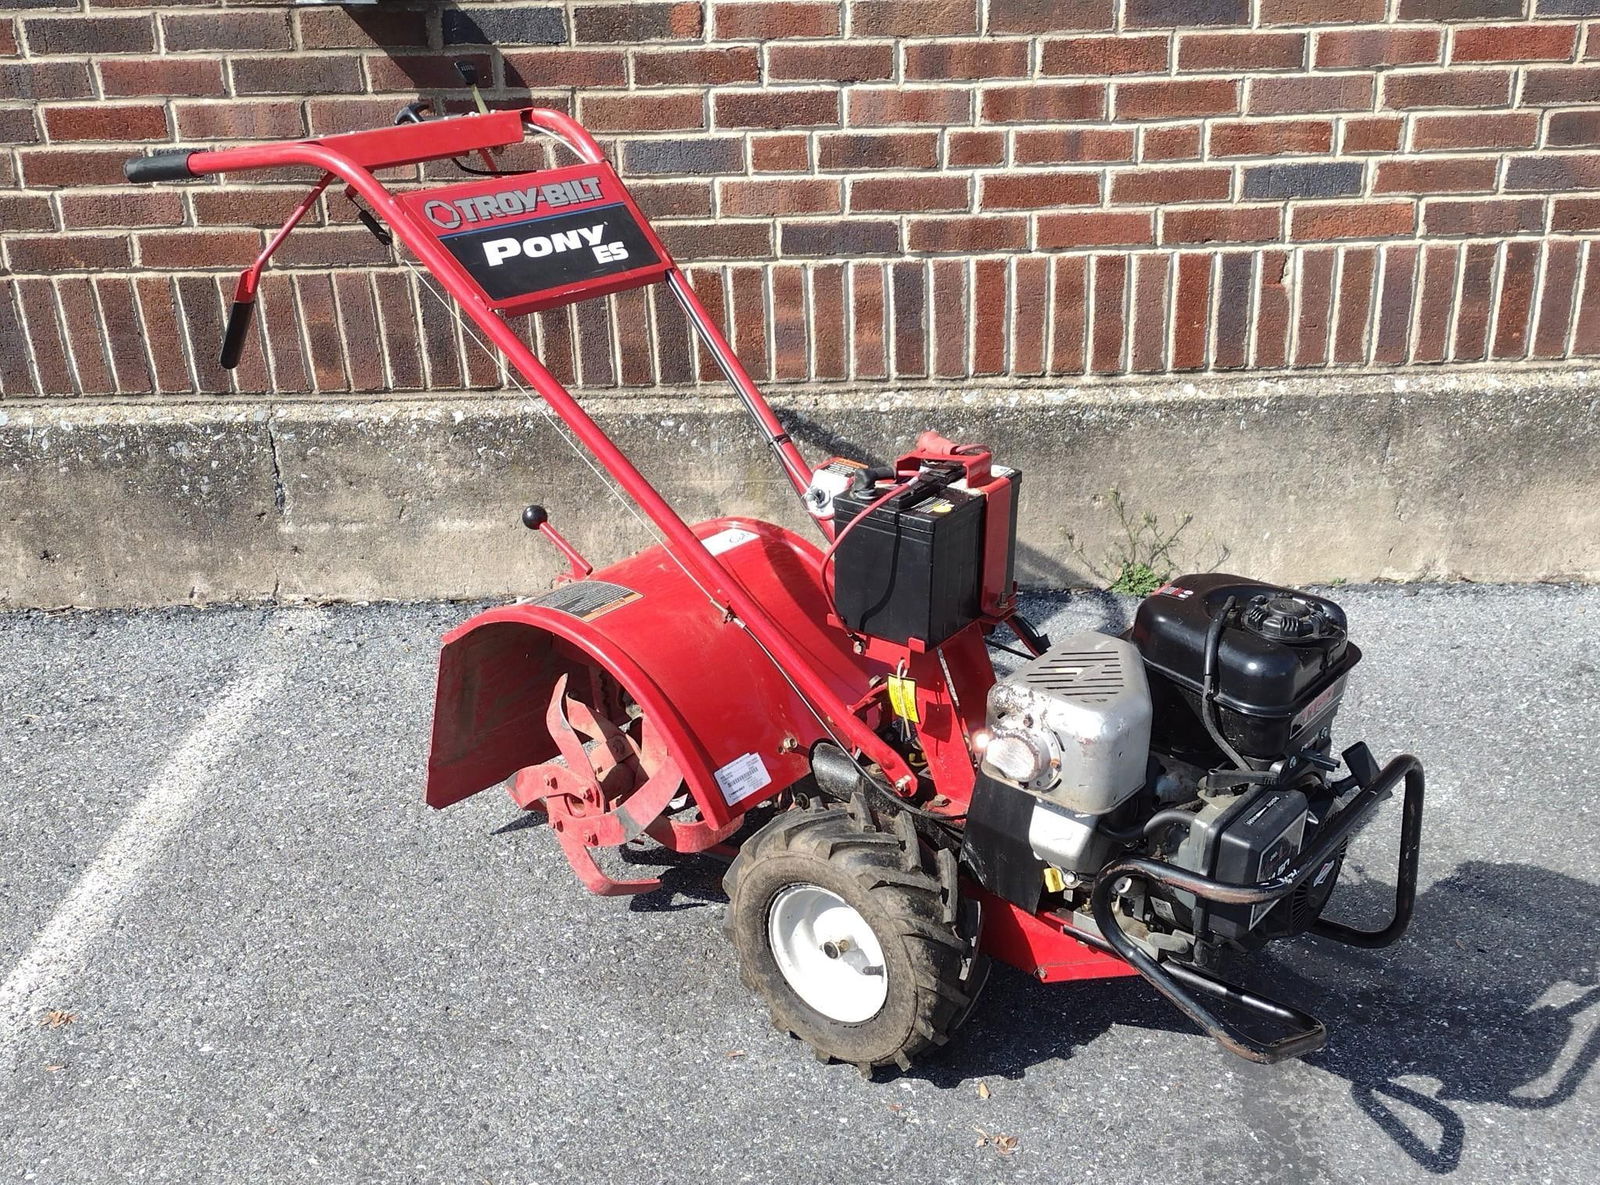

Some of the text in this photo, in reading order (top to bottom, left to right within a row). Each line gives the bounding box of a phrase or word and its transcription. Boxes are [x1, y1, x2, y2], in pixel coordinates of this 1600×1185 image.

[453, 177, 603, 222] TROY-BILT
[482, 224, 604, 267] PONY
[592, 241, 629, 265] ES
